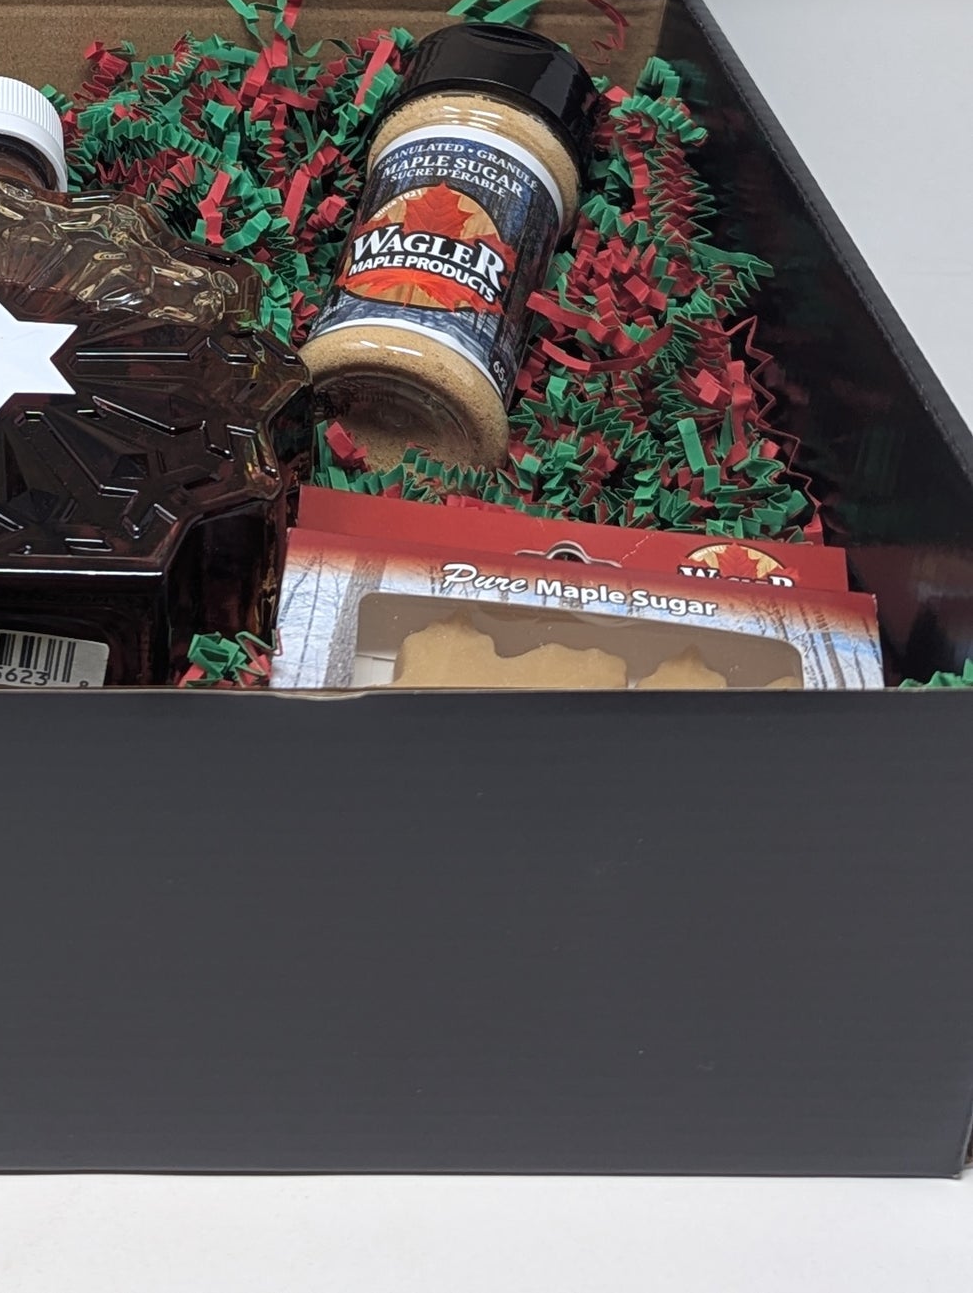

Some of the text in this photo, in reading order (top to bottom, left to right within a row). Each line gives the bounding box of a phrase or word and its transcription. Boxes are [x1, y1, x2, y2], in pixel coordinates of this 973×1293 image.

[377, 142, 540, 194] GRANULATED GRANULÉ
[380, 154, 524, 199] MAPLE SUGAR
[389, 167, 508, 198] SUCRE D'ÉRABLE
[348, 255, 496, 303] MAPLE PRODUCTS
[353, 224, 506, 293] WAGLER
[441, 563, 718, 617] Pure Maple Sugar
